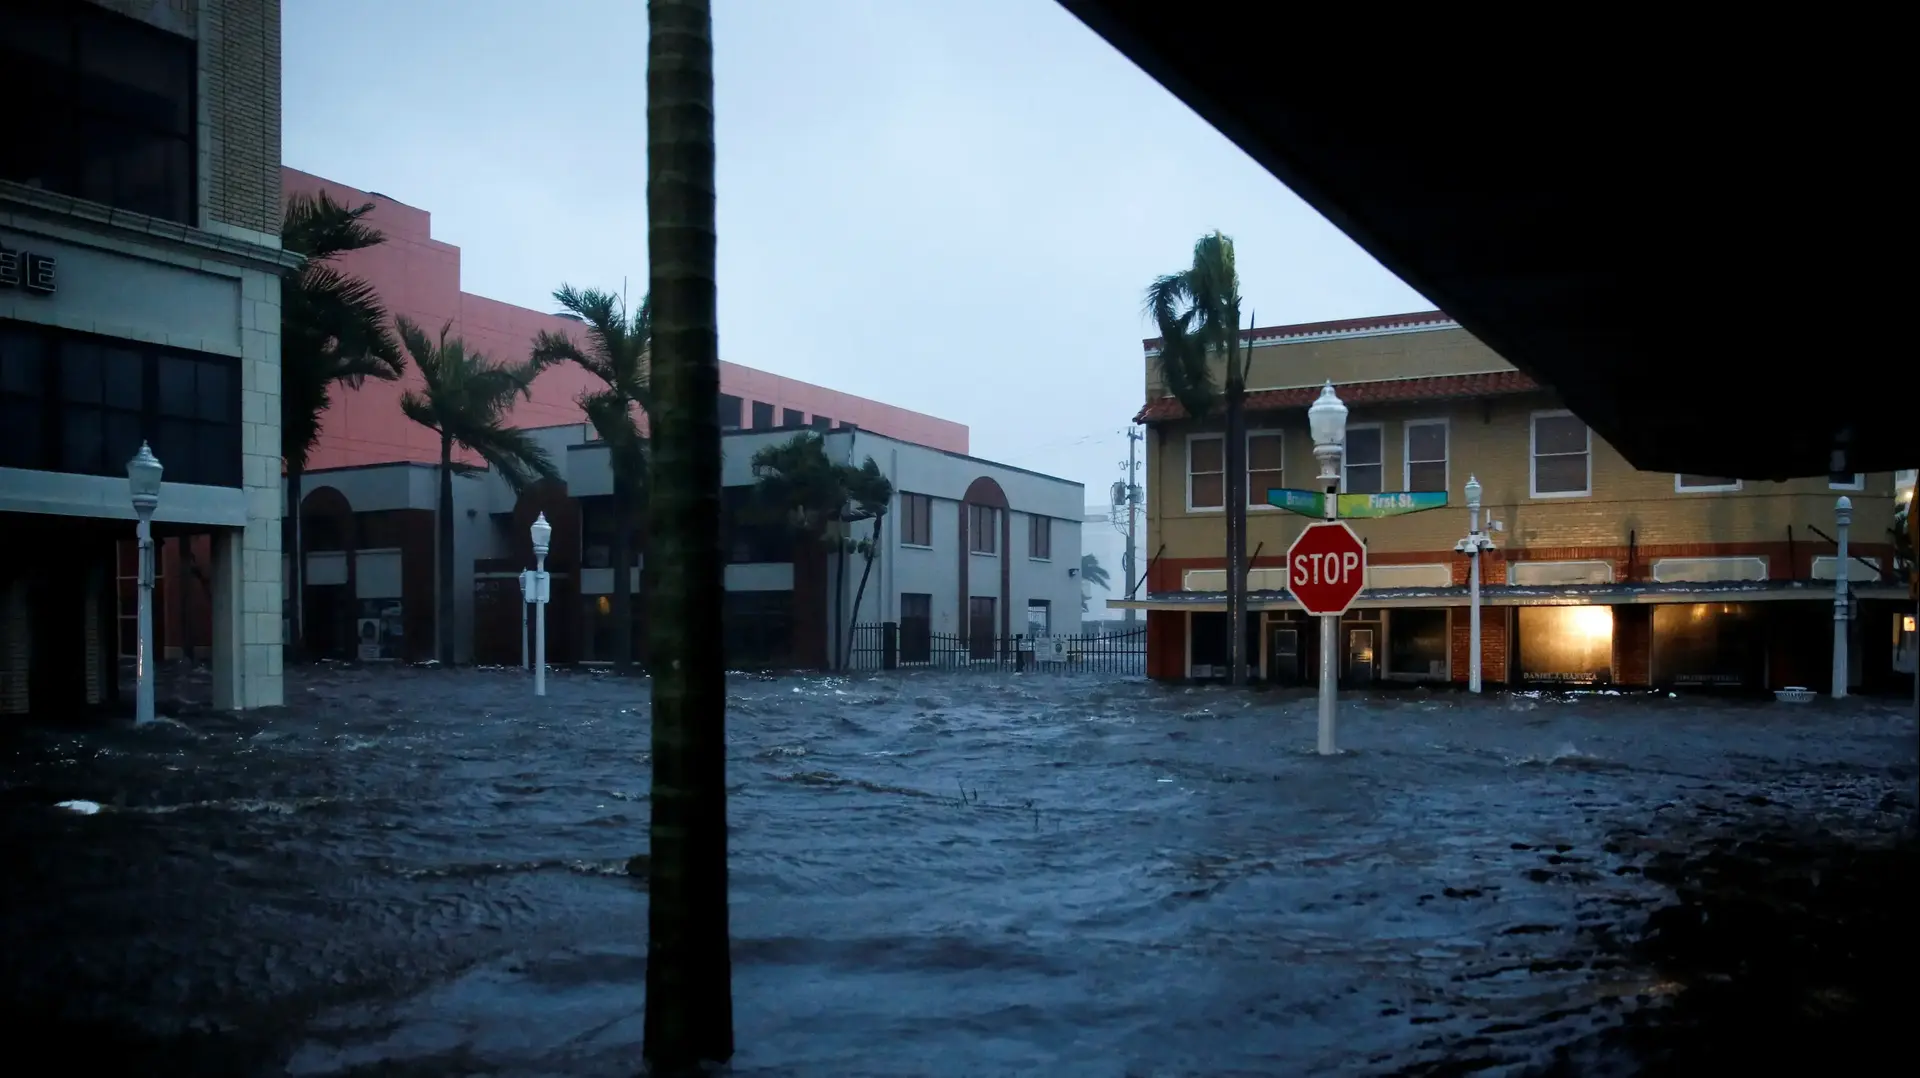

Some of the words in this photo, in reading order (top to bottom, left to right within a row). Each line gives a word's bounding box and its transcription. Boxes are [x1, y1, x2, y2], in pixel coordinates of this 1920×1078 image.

[1369, 493, 1396, 508] First
[1293, 552, 1360, 586] STOP
[1523, 672, 1551, 680] DANIEL
